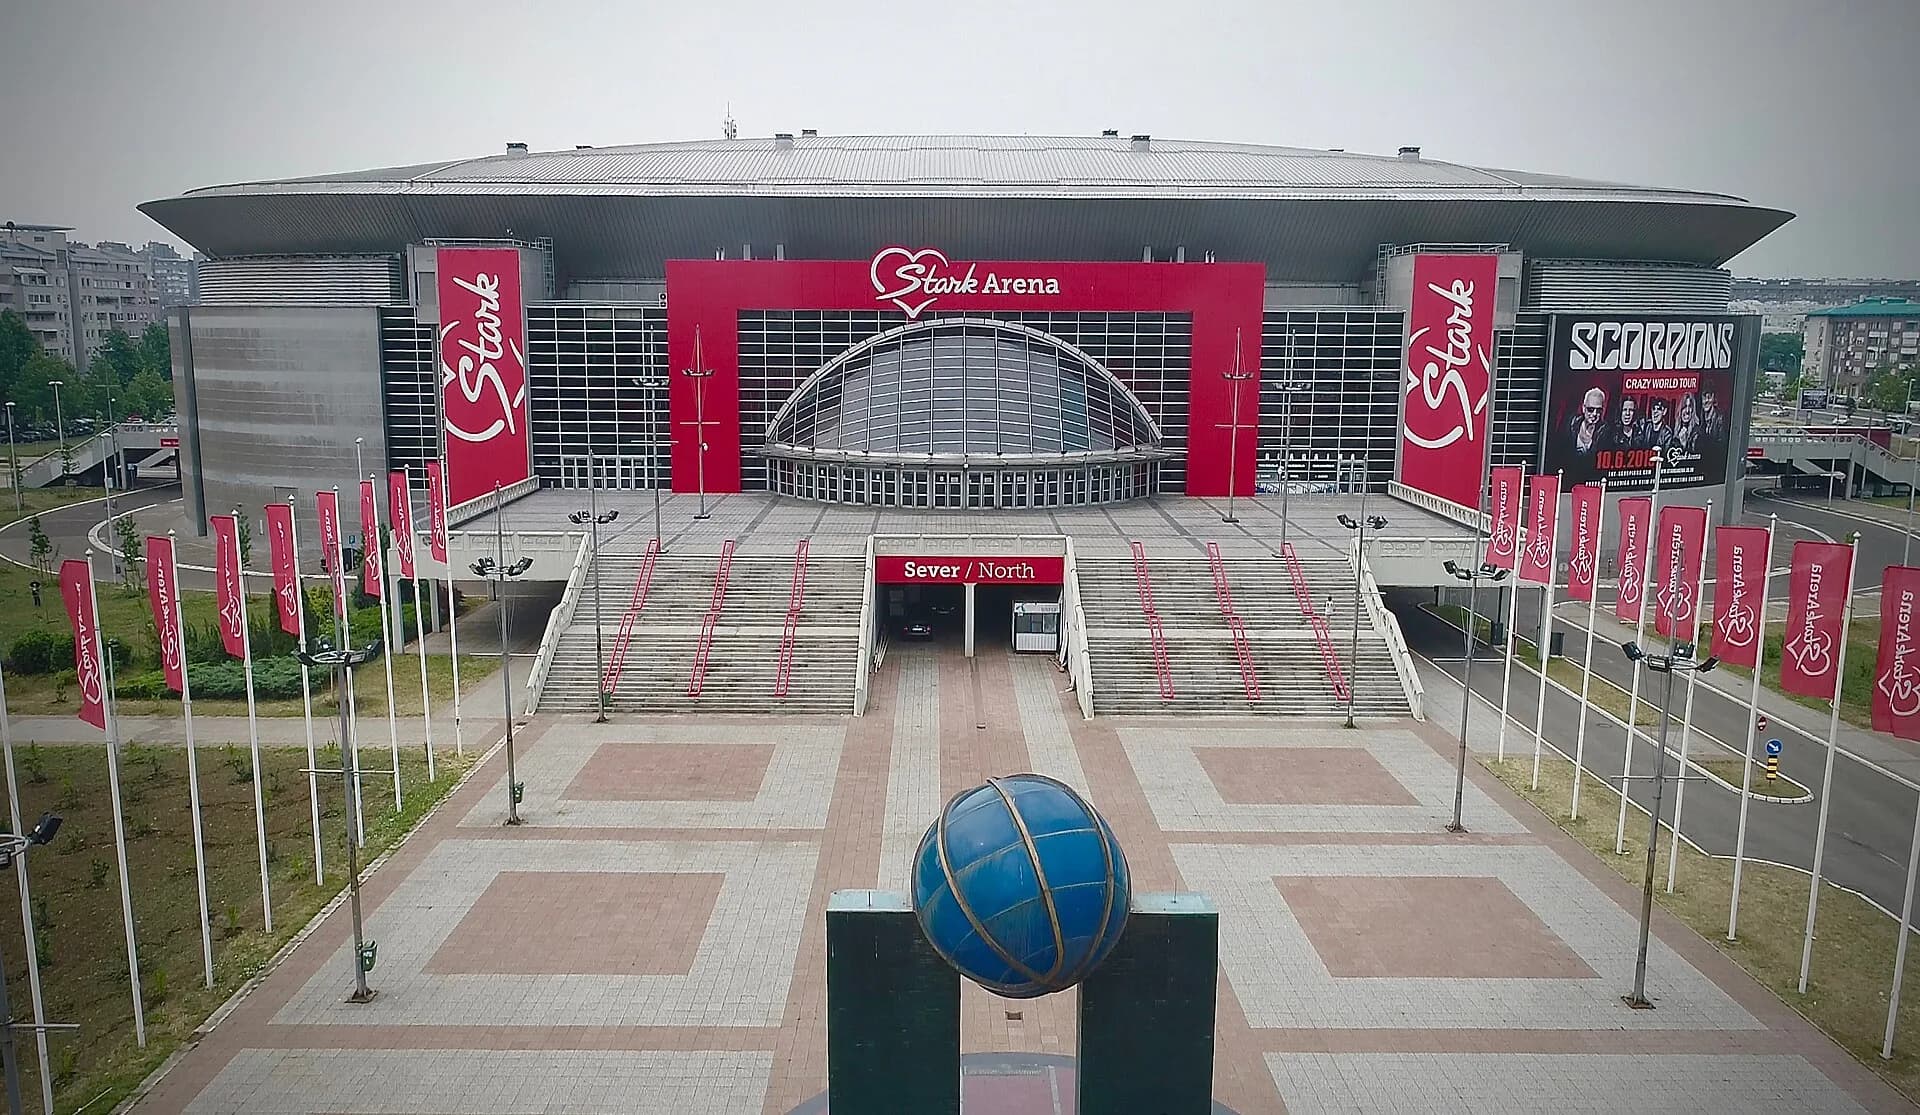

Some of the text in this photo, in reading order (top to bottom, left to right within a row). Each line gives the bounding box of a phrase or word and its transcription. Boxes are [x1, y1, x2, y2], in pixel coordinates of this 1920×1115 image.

[875, 263, 1060, 300] Stark Arena
[453, 273, 516, 434] Stark
[1423, 279, 1474, 441] Stark
[1569, 322, 1735, 370] SCORPIONS
[1625, 377, 1697, 390] CRAZY WORLD TOUR
[904, 561, 1035, 579] Sever / North
